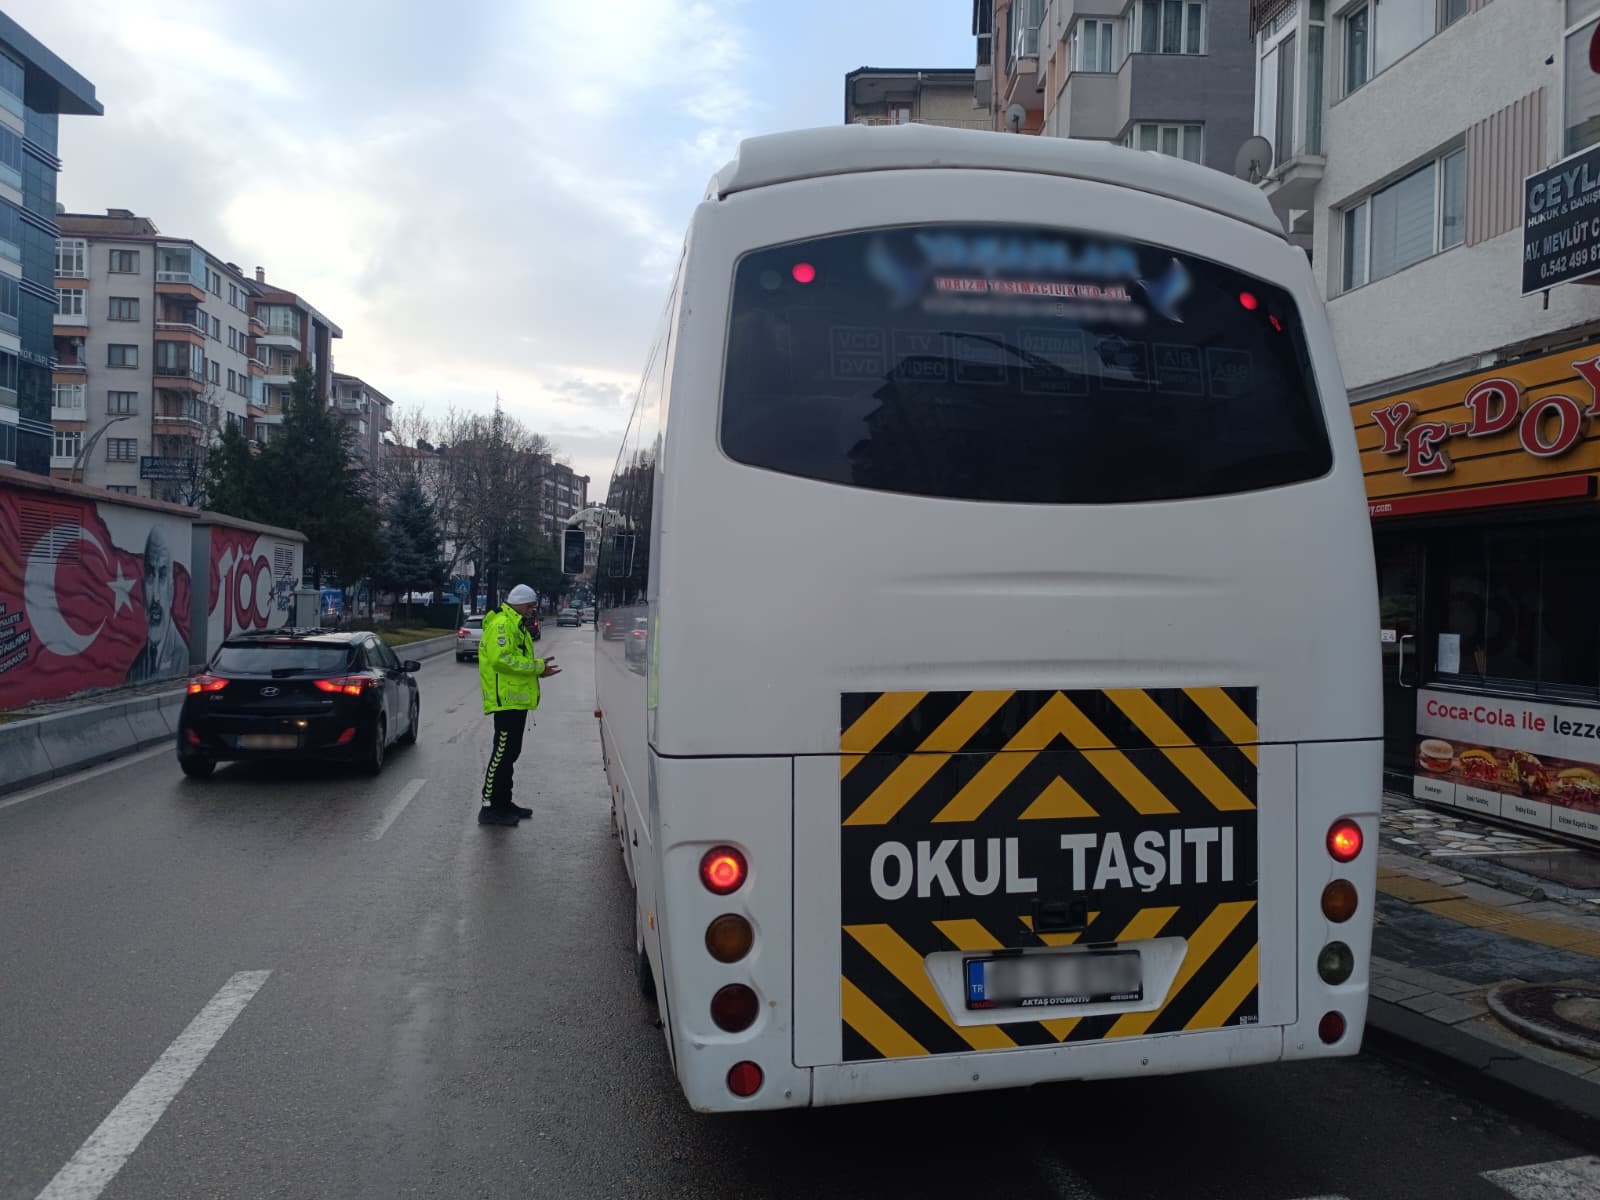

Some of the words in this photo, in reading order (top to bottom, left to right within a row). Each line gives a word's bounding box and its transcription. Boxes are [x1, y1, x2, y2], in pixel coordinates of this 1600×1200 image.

[1529, 163, 1600, 213] CEYL
[1527, 207, 1560, 228] HUKUK
[1561, 203, 1568, 215] &
[1525, 240, 1540, 262] AV.
[1543, 221, 1589, 256] MEVLÜT
[1541, 255, 1568, 279] 0.542
[1569, 248, 1588, 268] 499
[910, 335, 932, 352] TV
[1521, 711, 1546, 732] ile
[870, 837, 1037, 900] OKUL
[1060, 826, 1234, 892] TAŞITI
[971, 984, 984, 994] TR
[1021, 998, 1049, 1008] AKTAŞ
